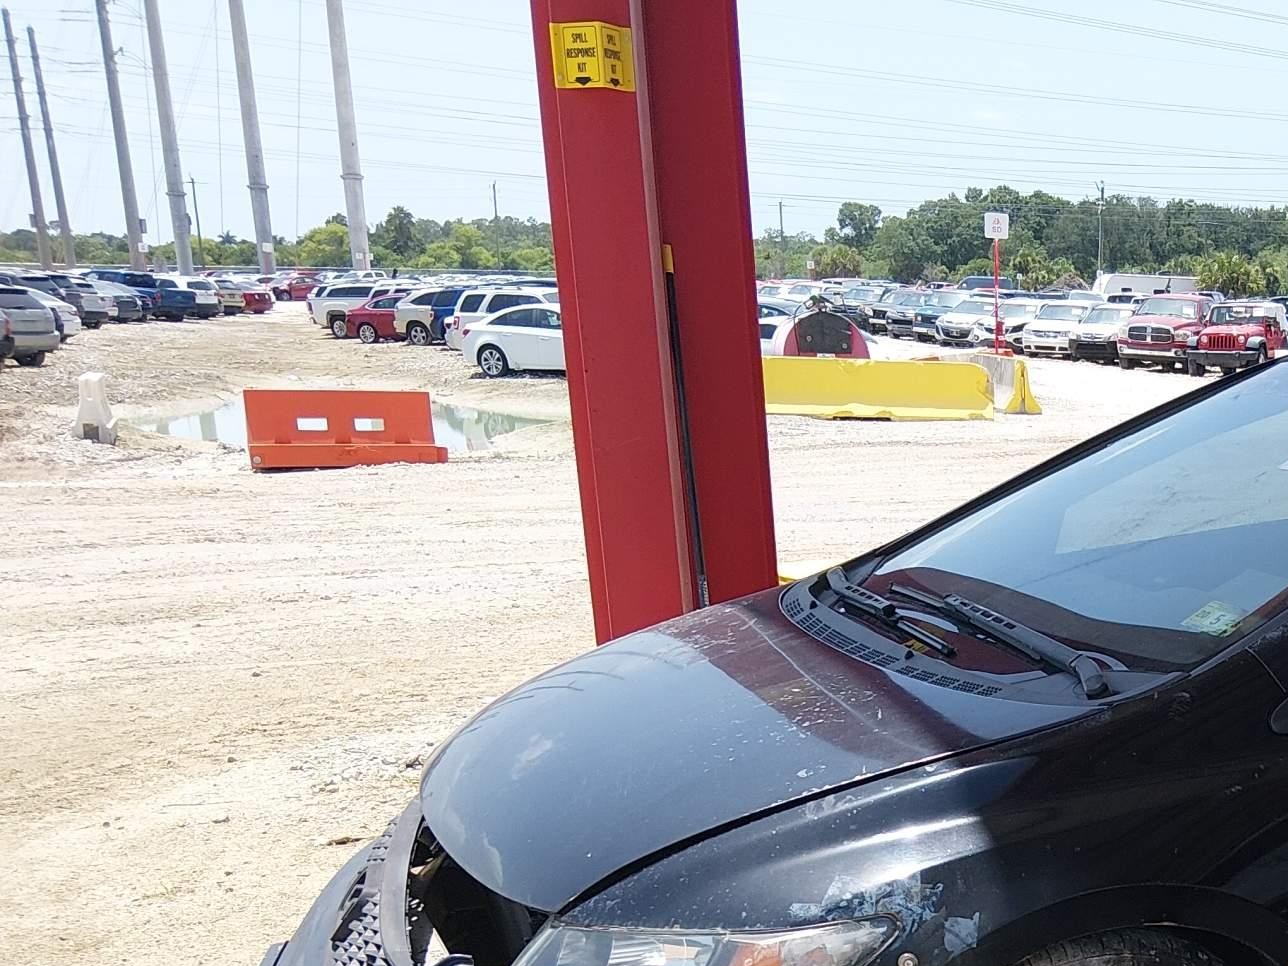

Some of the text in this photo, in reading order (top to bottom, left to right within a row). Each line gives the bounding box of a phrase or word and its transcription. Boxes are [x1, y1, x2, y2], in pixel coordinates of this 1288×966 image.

[571, 32, 588, 43] SPILL
[566, 47, 597, 58] RESPONSE
[577, 62, 587, 72] KIT
